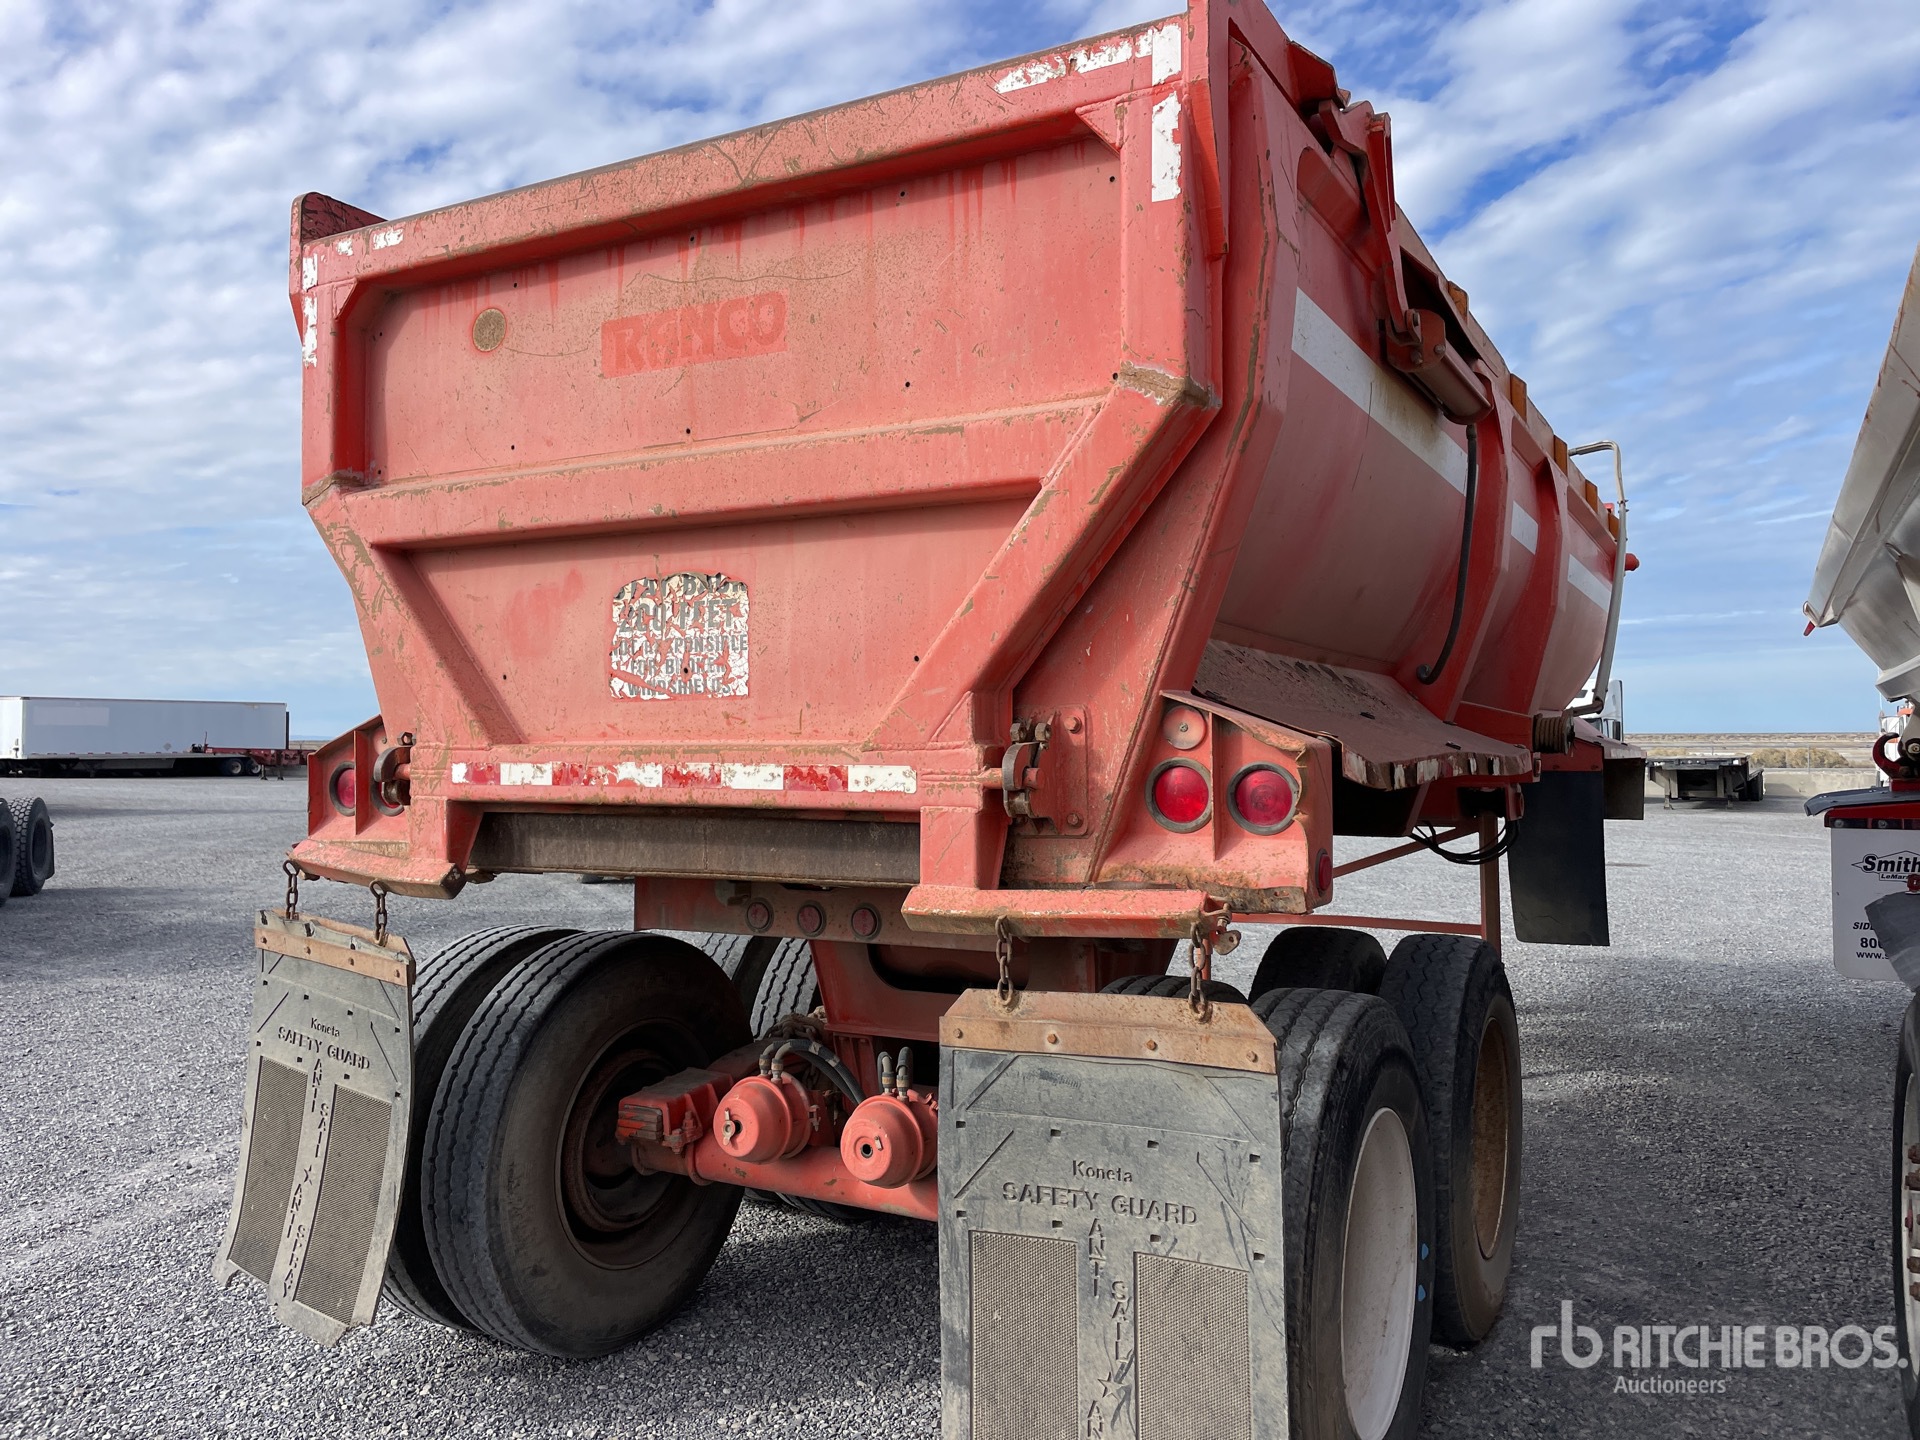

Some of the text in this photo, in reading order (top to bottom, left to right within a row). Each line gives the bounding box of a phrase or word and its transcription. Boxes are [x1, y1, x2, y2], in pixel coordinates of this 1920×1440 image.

[278, 1026, 370, 1070] SAFETY GUARD
[1072, 1159, 1133, 1183] Koneta
[1002, 1181, 1198, 1226] SAFETY GUARD
